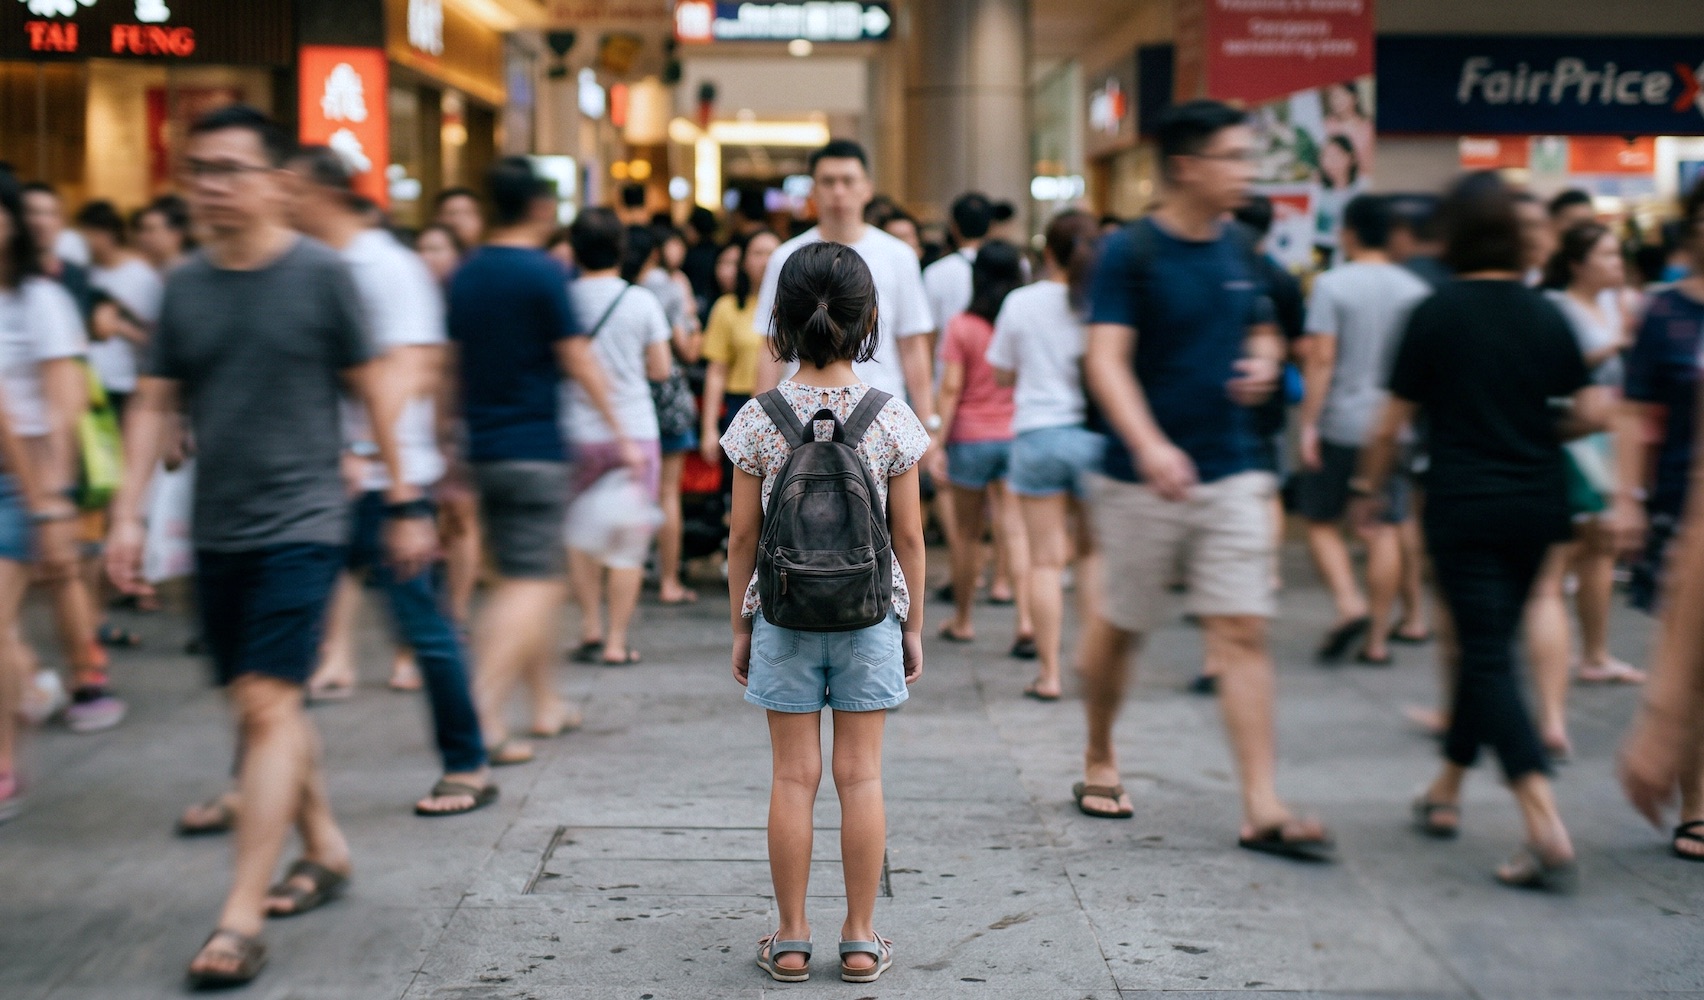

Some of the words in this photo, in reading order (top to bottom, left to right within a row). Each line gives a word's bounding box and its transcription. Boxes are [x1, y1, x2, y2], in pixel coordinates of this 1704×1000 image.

[25, 21, 79, 52] TAI
[111, 24, 195, 56] FUNG
[1458, 56, 1672, 104] FairPrice
